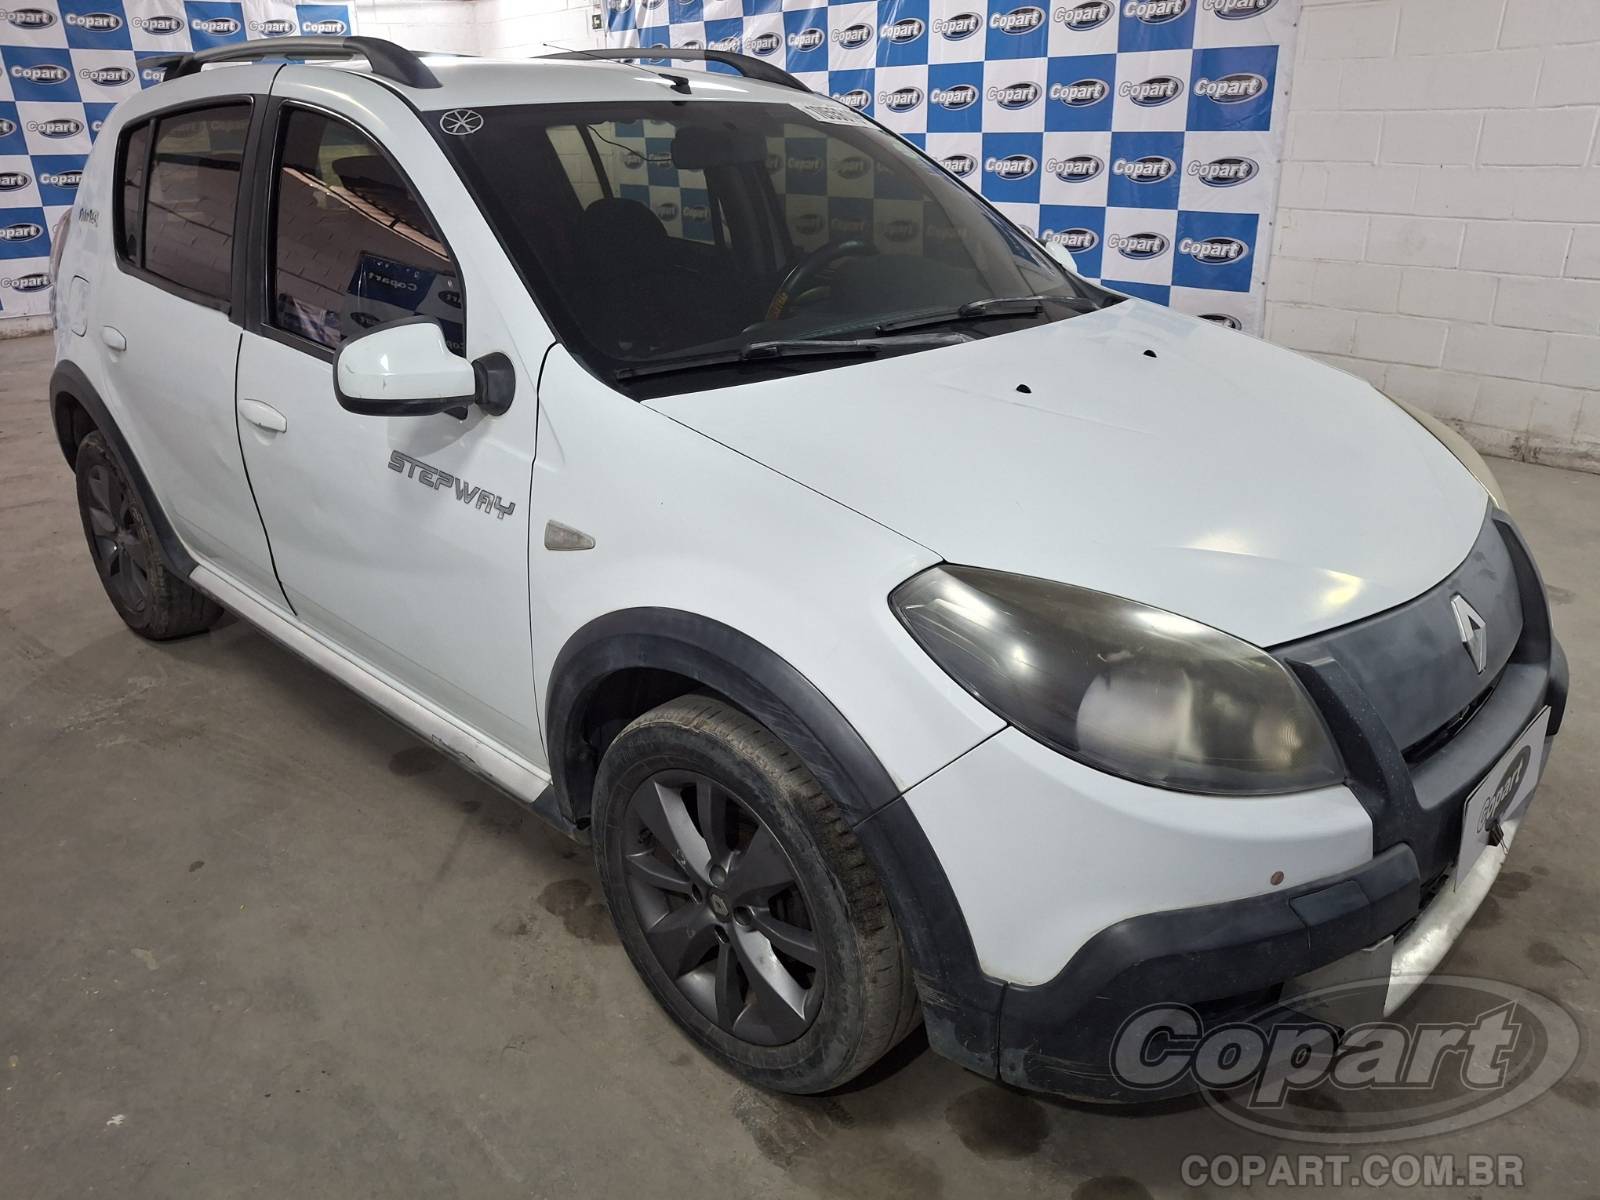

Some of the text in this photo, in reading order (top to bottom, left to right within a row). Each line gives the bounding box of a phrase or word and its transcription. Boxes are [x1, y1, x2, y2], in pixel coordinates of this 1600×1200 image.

[1054, 4, 1109, 24] Copart
[1123, 0, 1182, 18] Copart
[0, 10, 50, 25] Copart
[66, 14, 117, 29] Copart
[132, 17, 179, 30] Copart
[192, 19, 235, 32] Copart
[990, 10, 1039, 30] Copart
[250, 21, 290, 32] Copart
[302, 22, 342, 33] Copart
[880, 23, 920, 41] Copart
[933, 18, 976, 34] Copart
[745, 37, 778, 51] Copart
[787, 31, 820, 46] Copart
[831, 28, 868, 44] Copart
[11, 65, 64, 81] Copart
[79, 69, 130, 83] Copart
[987, 85, 1037, 105] Copart
[1050, 82, 1104, 102] Copart
[1119, 80, 1175, 100] Copart
[1194, 77, 1257, 99] Copart
[878, 90, 920, 106] Copart
[931, 88, 974, 105] Copart
[27, 121, 76, 133] Copart
[985, 157, 1031, 173] Copart
[1046, 157, 1096, 174] Copart
[1113, 158, 1170, 178] Copart
[1187, 160, 1250, 178] Copart
[40, 173, 82, 186] Copar
[1108, 233, 1163, 252] Copart
[1180, 238, 1241, 258] Copart
[1, 273, 49, 289] Copart
[388, 450, 516, 520] STEPWAY
